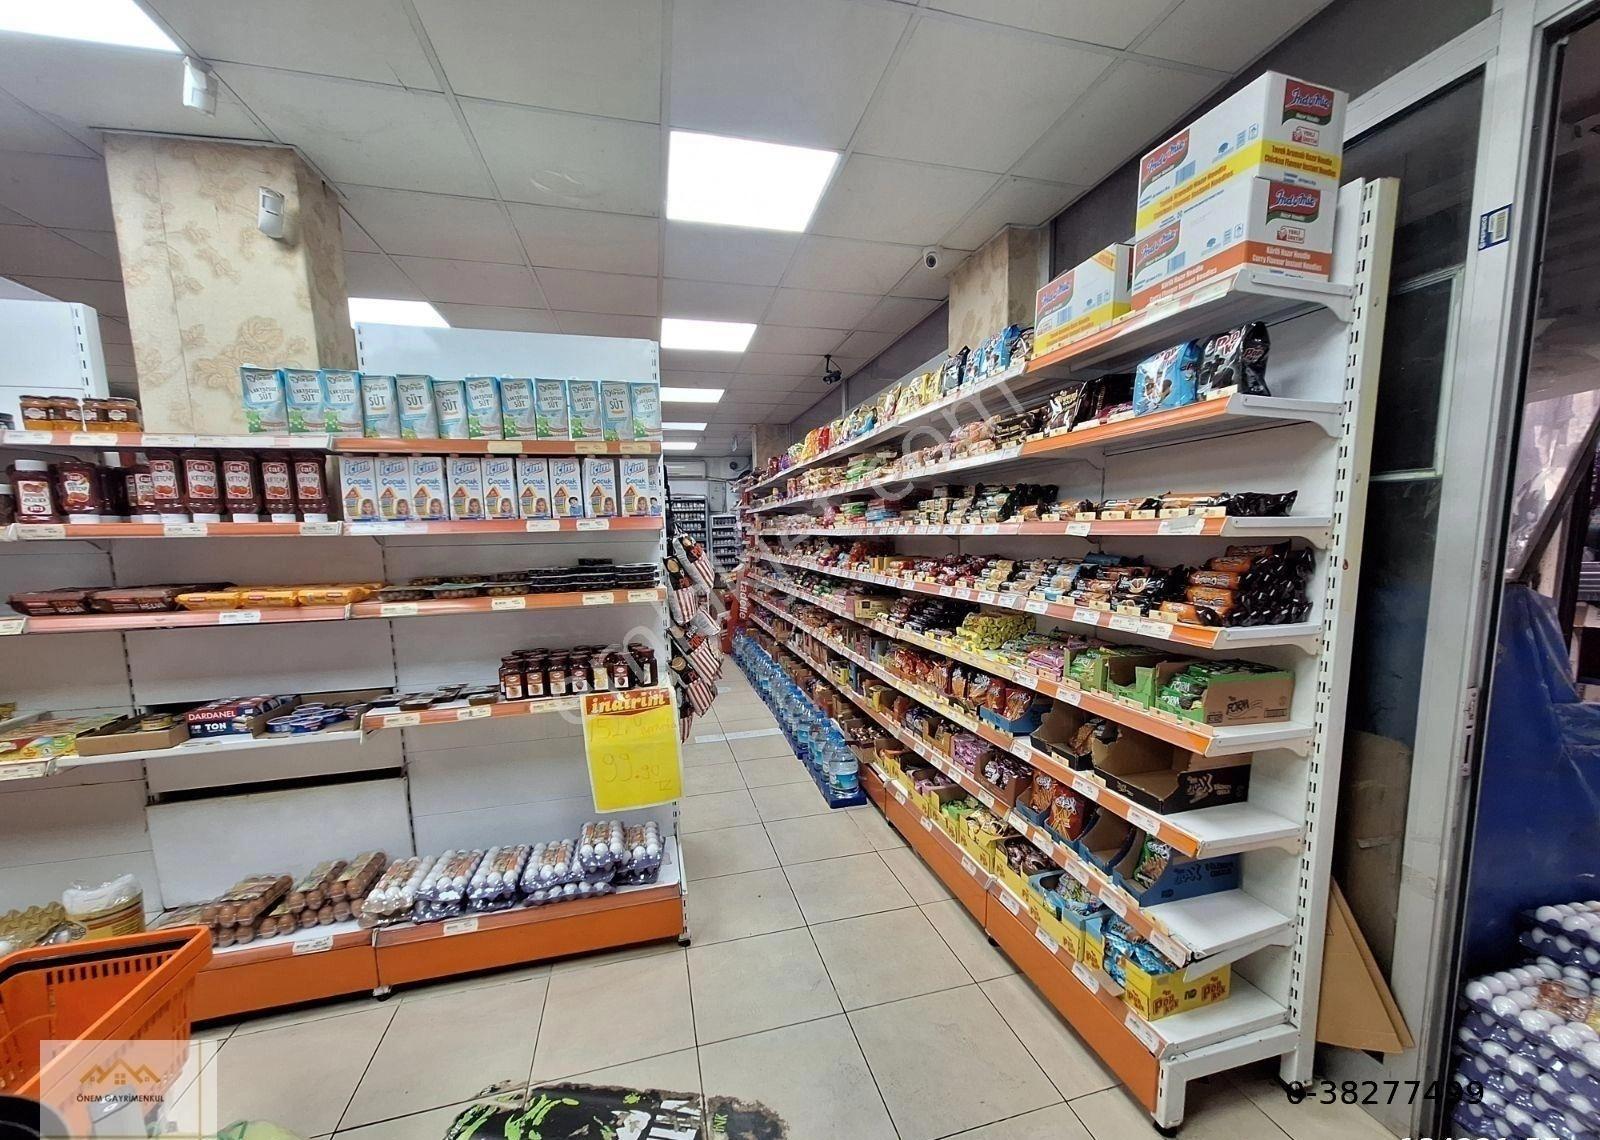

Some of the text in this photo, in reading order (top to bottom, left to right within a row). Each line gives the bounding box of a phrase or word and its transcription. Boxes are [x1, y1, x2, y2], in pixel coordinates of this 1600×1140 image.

[368, 394, 385, 406] SÜT
[406, 393, 423, 406] SÜT
[442, 399, 458, 411] SÜT
[609, 398, 624, 409] SÜT
[590, 690, 666, 714] indirim
[188, 710, 237, 721] DARDANEL
[205, 722, 227, 730] TON
